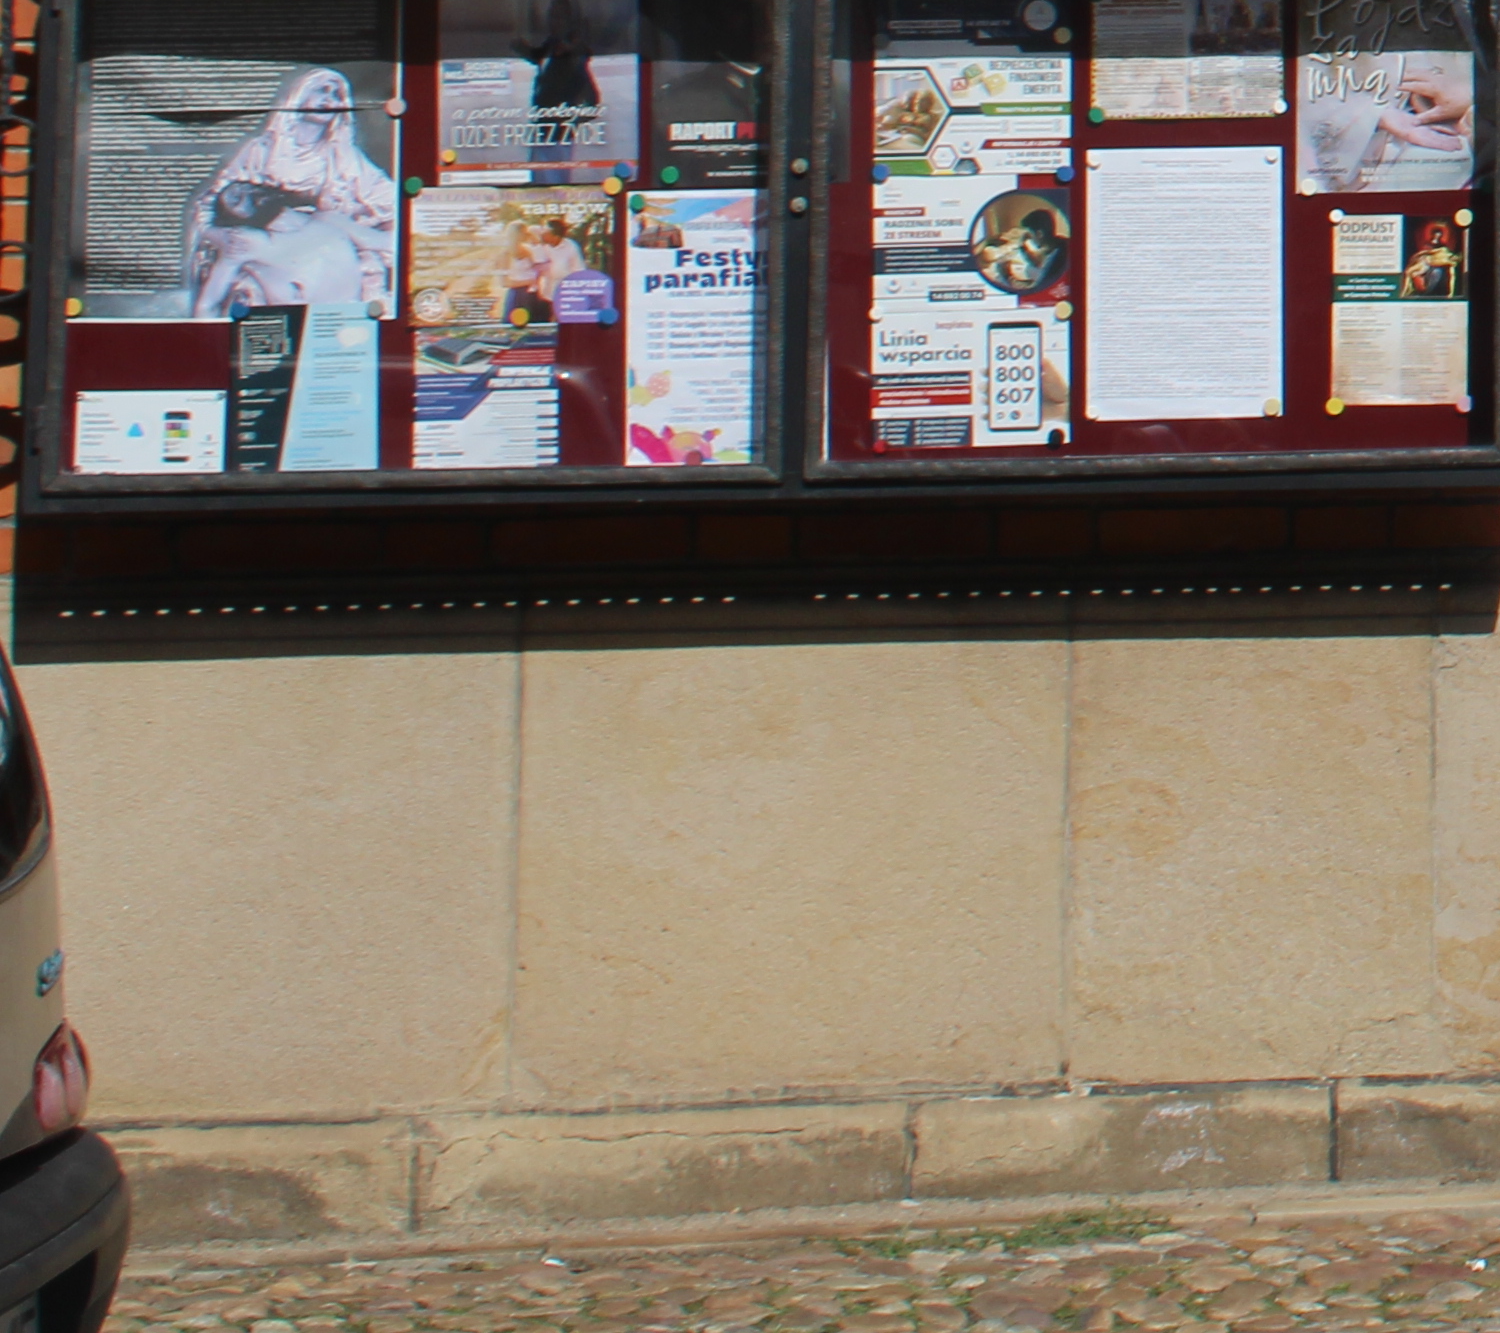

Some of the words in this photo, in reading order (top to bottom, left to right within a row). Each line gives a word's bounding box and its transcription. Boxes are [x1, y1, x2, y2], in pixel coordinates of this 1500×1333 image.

[667, 122, 738, 141] RAPORT
[1340, 221, 1395, 233] ODPUST
[643, 267, 768, 293] parafial
[879, 330, 928, 347] Linia
[879, 344, 972, 366] wsparcia
[995, 344, 1035, 360] 800
[995, 366, 1035, 382] 800
[995, 387, 1036, 404] 607
